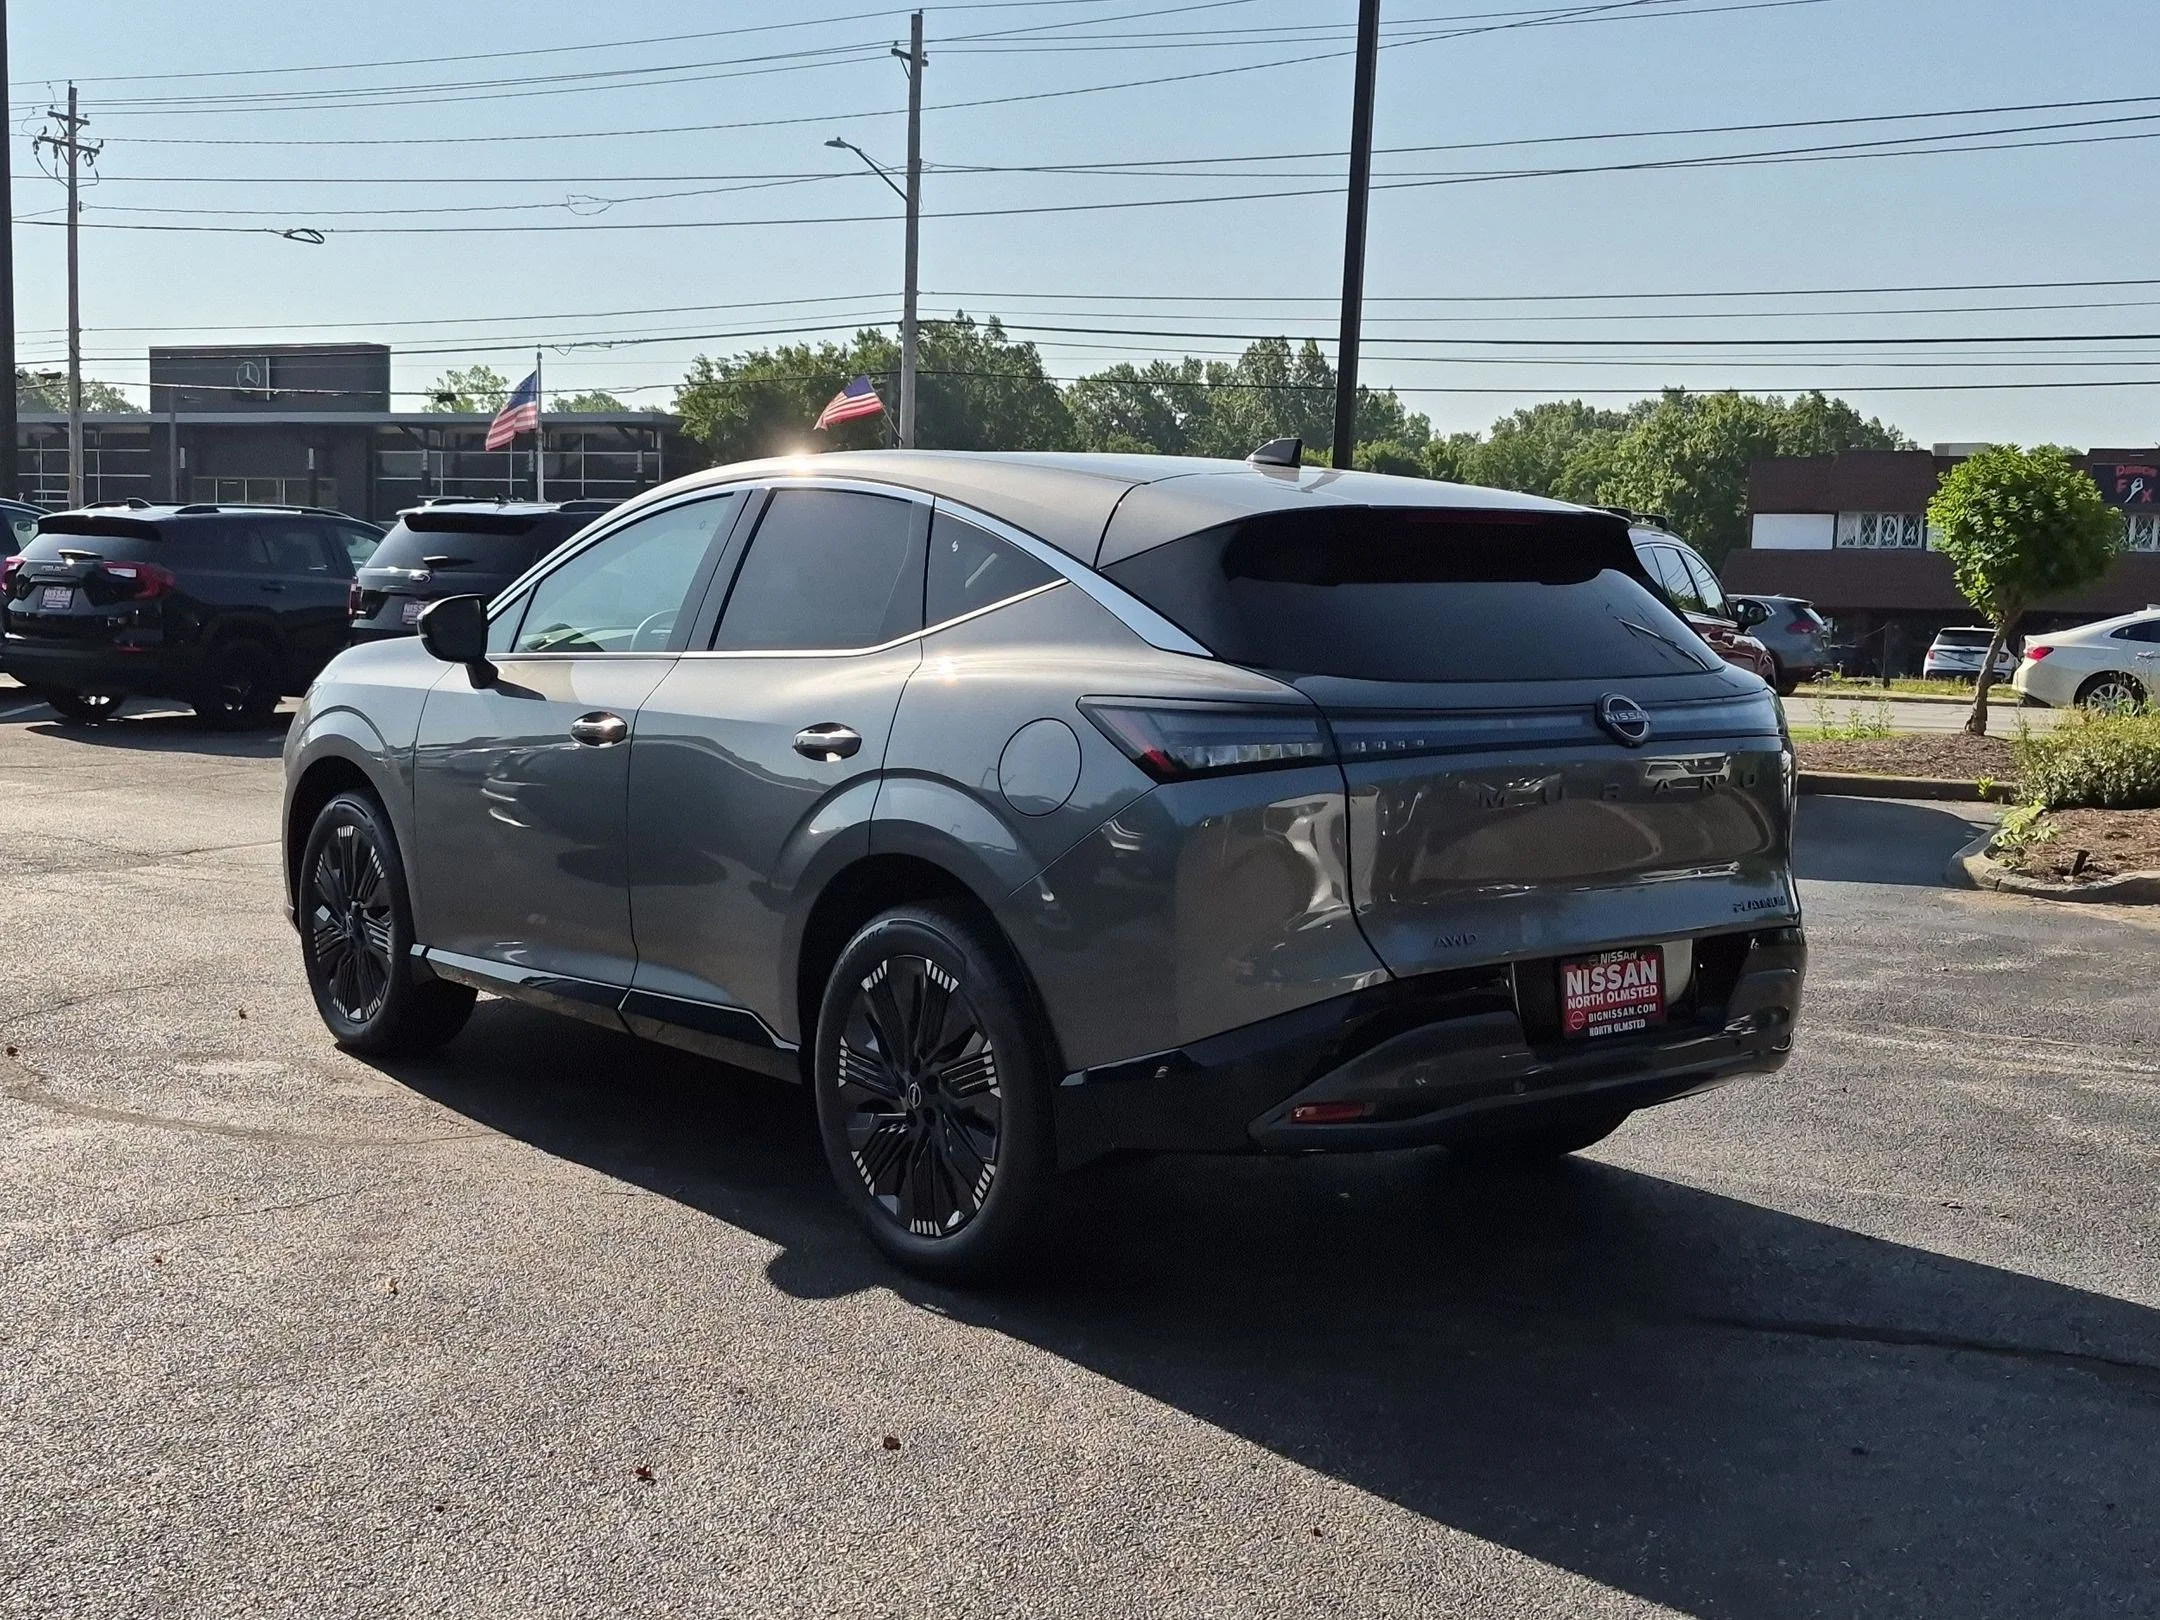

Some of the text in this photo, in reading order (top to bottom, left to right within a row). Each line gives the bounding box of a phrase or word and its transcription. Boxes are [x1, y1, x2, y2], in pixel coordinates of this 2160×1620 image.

[1433, 931, 1477, 949] AWD
[1600, 951, 1637, 964] NISSAN
[1566, 960, 1657, 996] NISSAN
[1568, 985, 1657, 1009] NORTH OLMSTED
[1589, 1018, 1646, 1037] NORTH OLMSTED
